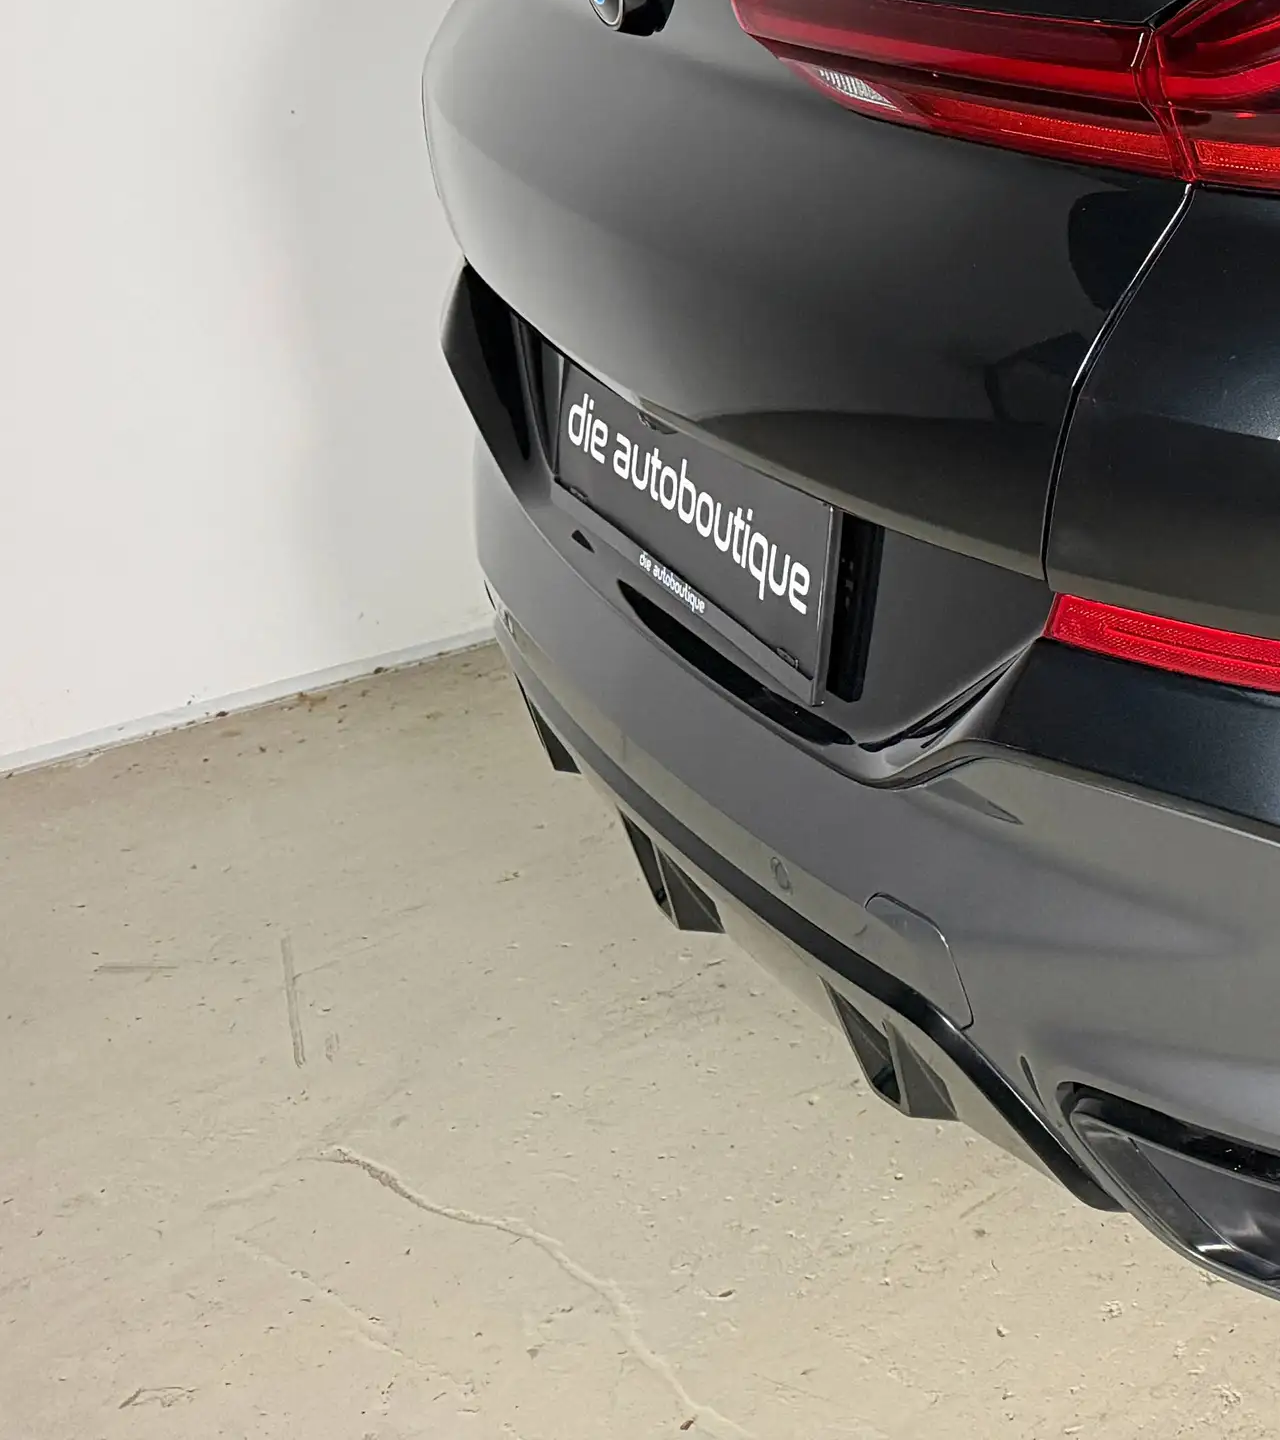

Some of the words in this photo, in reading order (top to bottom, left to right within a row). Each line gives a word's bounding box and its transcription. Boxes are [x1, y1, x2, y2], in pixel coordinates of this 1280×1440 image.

[567, 393, 609, 465] die
[612, 431, 811, 616] autoboutique
[639, 550, 652, 572] die
[652, 564, 706, 614] autoboutique
